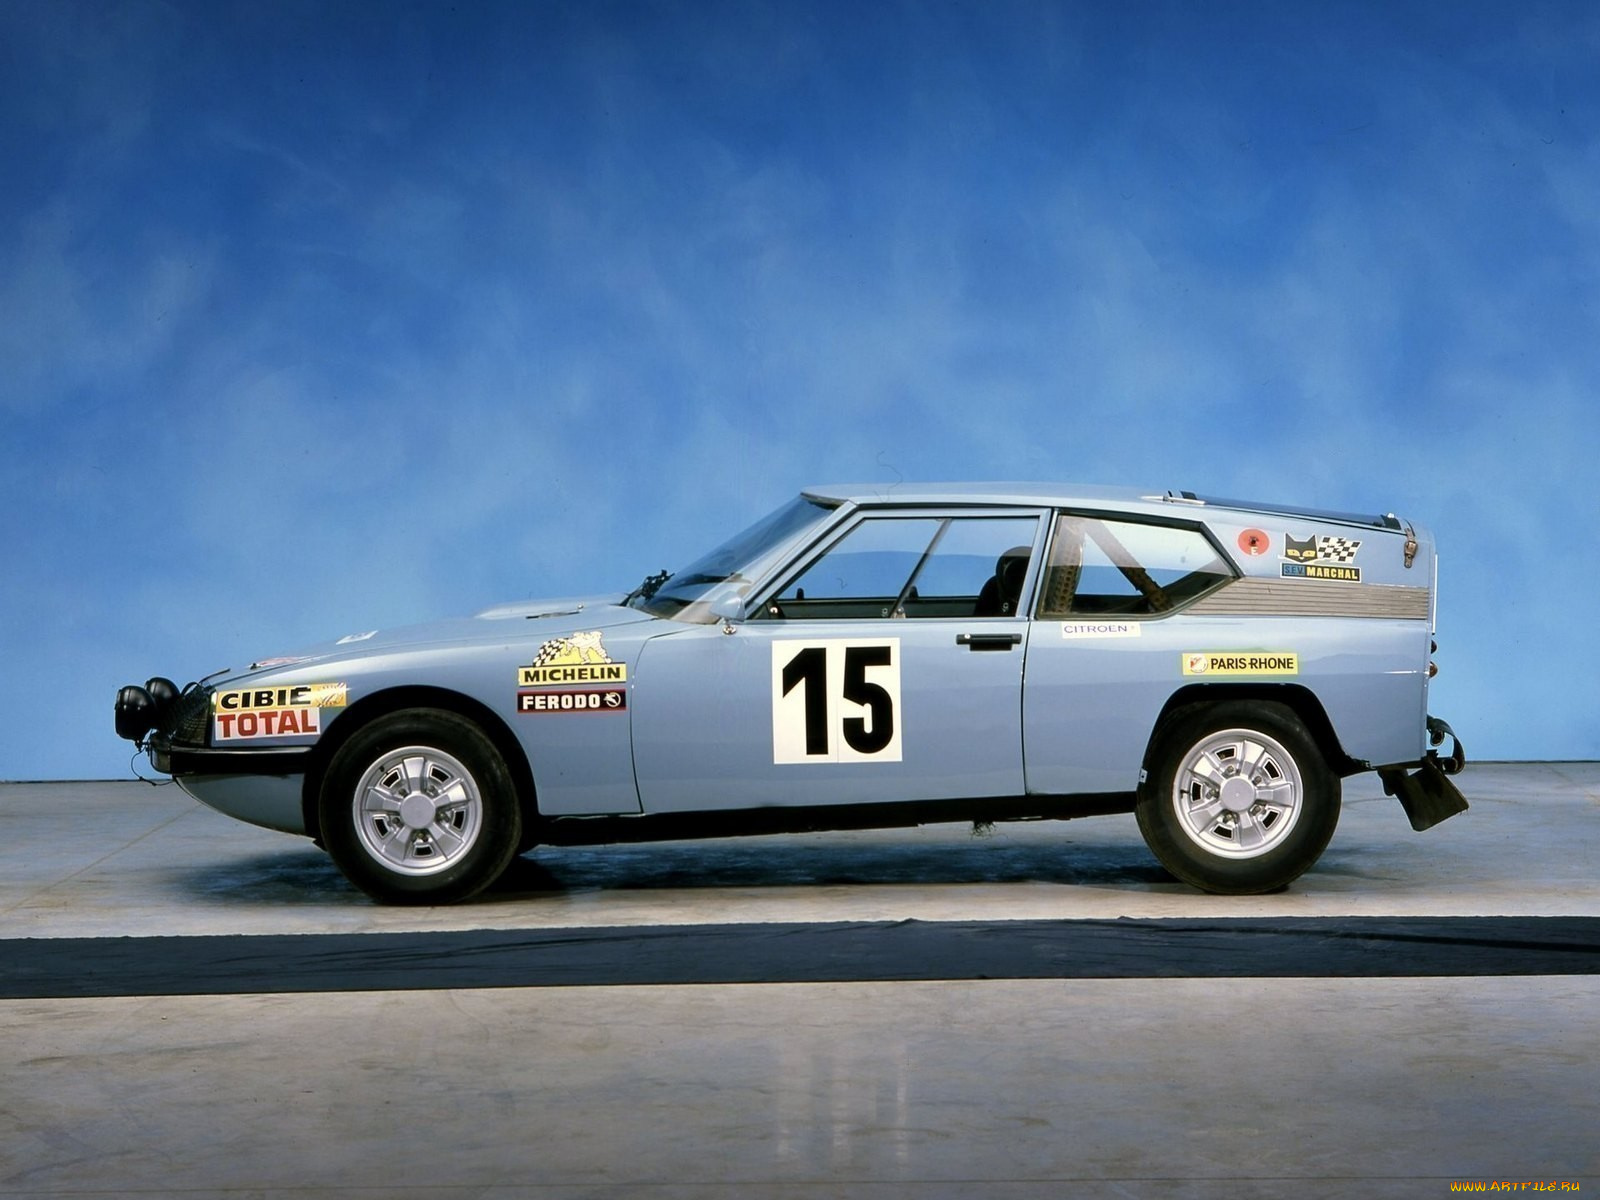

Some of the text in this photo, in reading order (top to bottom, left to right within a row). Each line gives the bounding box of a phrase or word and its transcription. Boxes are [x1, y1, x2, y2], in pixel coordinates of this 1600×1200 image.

[1306, 567, 1359, 580] MARCHAL
[524, 666, 621, 682] MICHELIN
[522, 694, 601, 710] FERODO
[783, 646, 894, 755] 15
[217, 709, 318, 738] TOTAL
